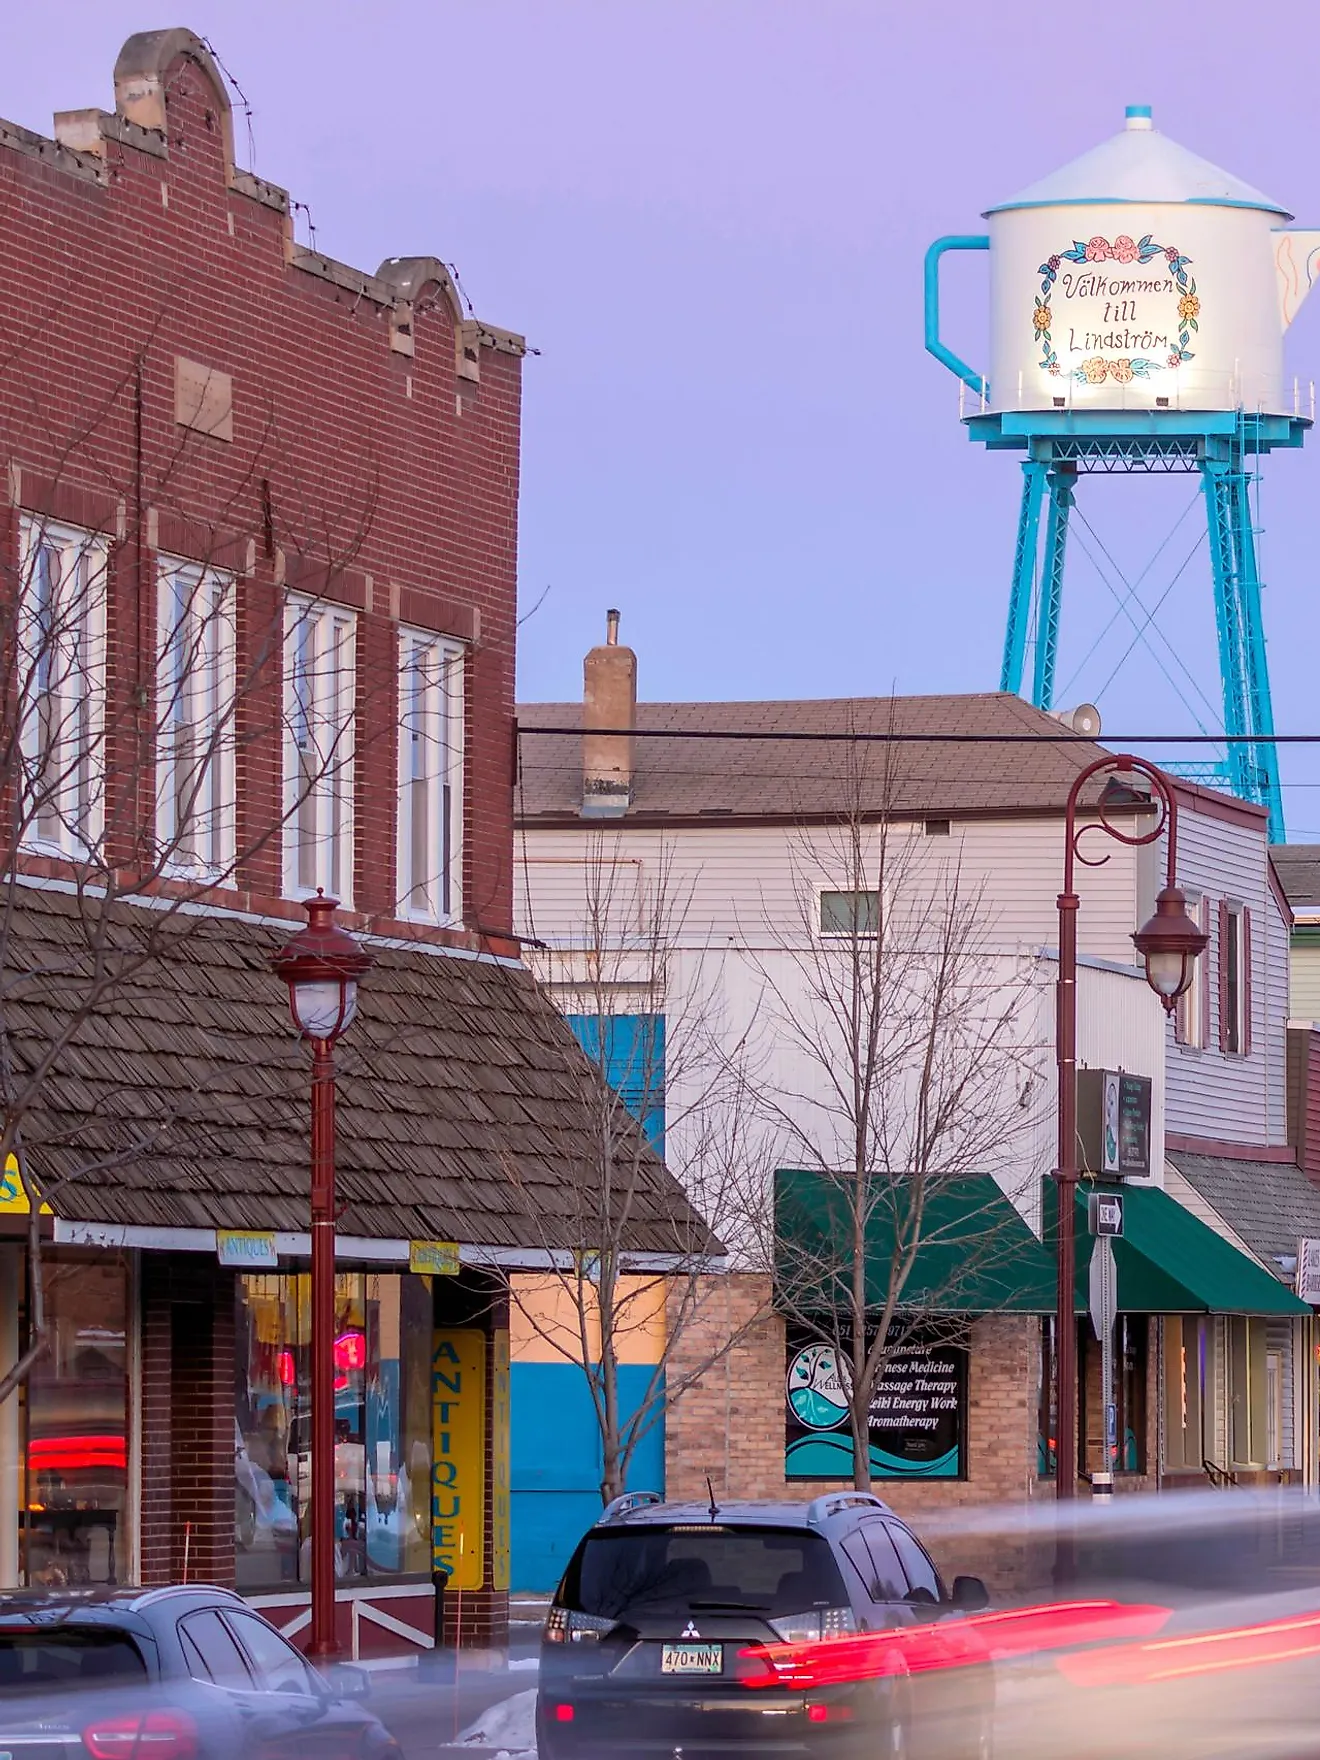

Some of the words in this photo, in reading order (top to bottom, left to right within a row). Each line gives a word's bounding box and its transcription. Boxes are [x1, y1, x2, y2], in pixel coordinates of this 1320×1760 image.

[1062, 272, 1174, 298] Välkommen
[1103, 300, 1136, 322] till
[1069, 328, 1168, 352] Lindström
[908, 1361, 955, 1373] Medicine
[871, 1381, 915, 1393] assage
[914, 1380, 957, 1393] Therapy
[892, 1397, 929, 1412] Energy
[930, 1397, 958, 1409] Work
[432, 1341, 461, 1577] ANTIQUES
[665, 1651, 688, 1666] 470
[696, 1651, 719, 1666] NNX
